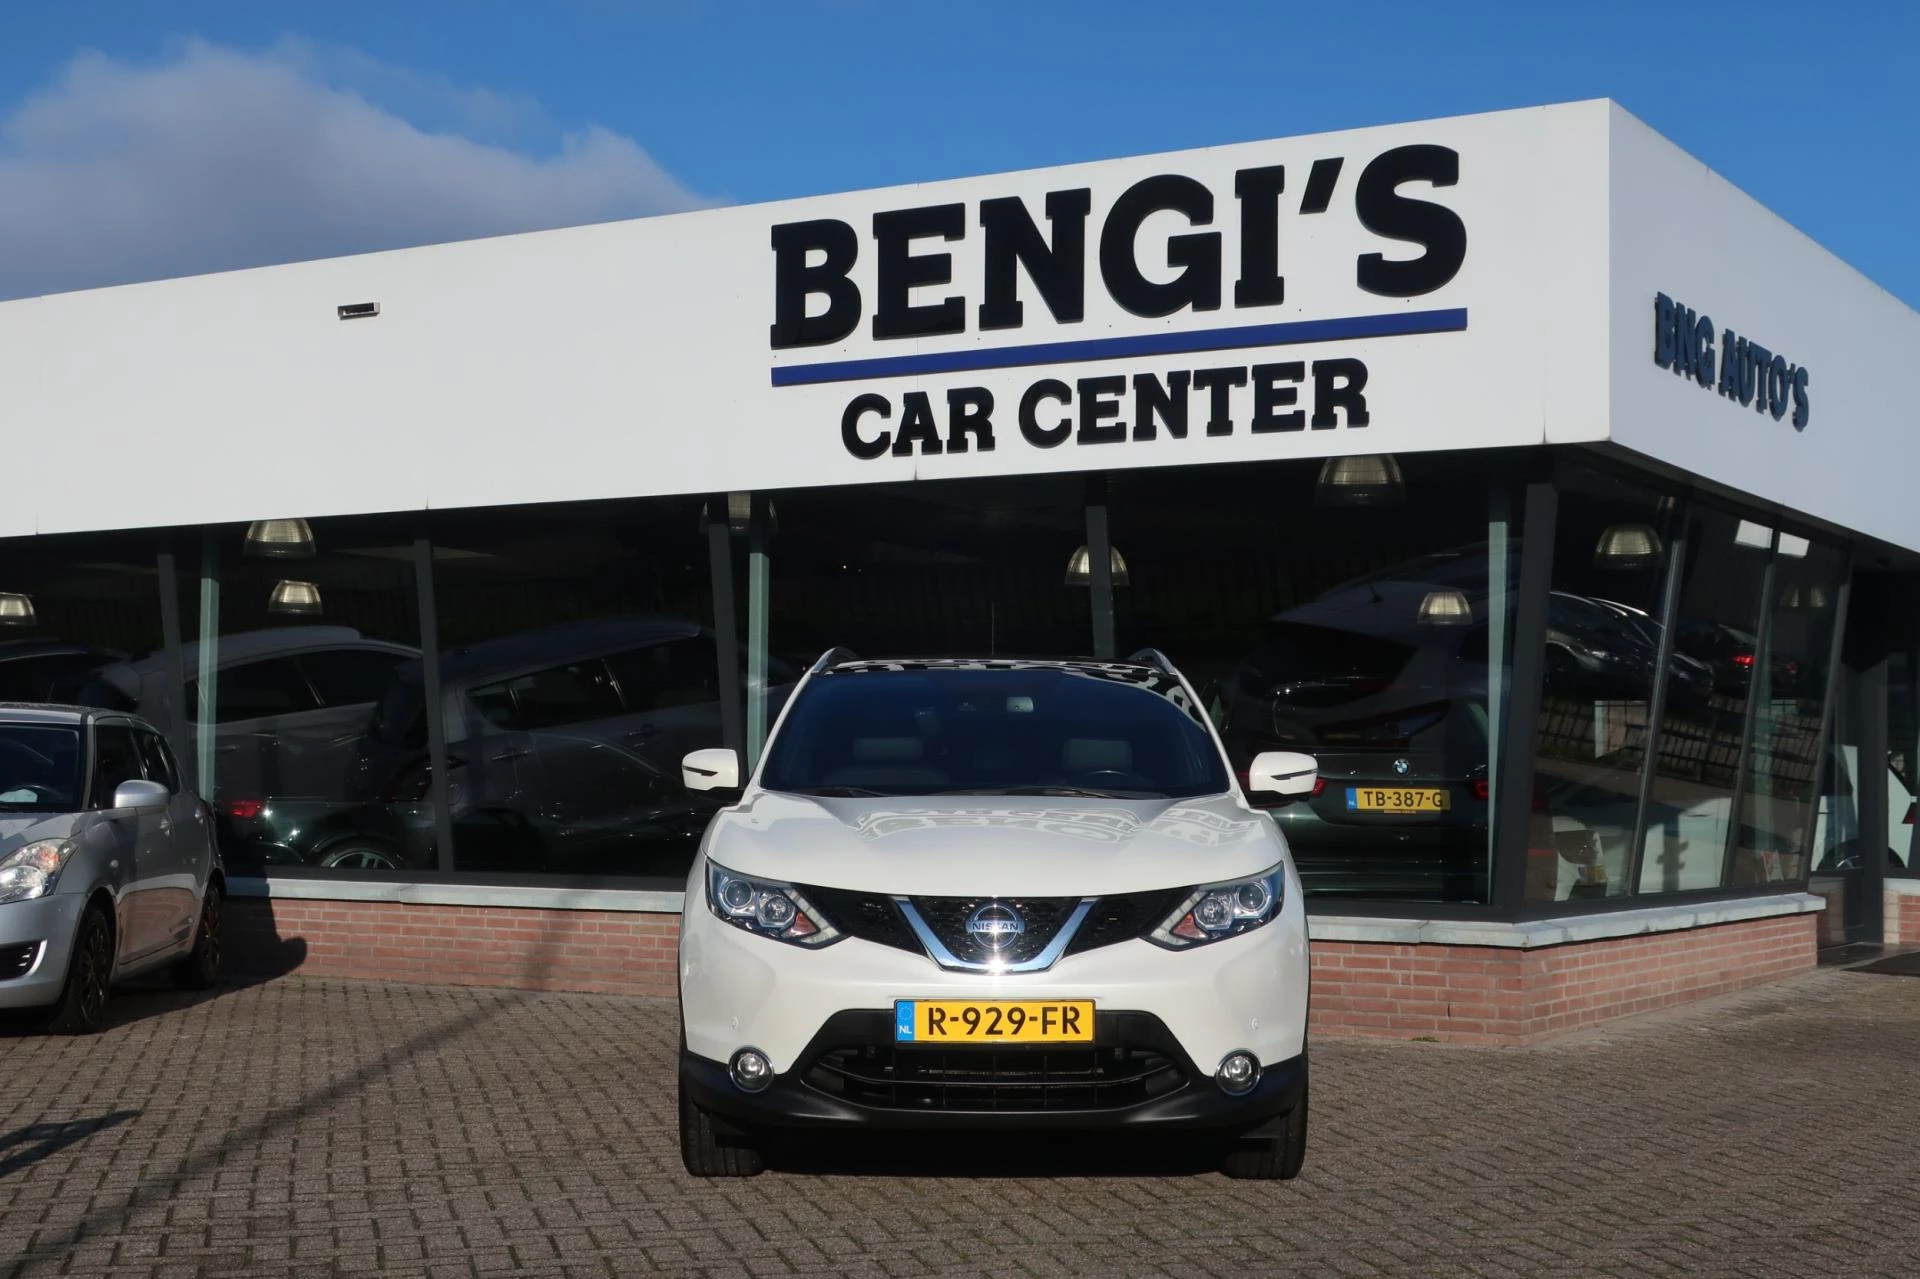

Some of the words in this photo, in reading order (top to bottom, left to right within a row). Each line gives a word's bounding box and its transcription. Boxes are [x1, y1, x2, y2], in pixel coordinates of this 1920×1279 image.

[770, 144, 1467, 350] BENGI'S
[1654, 291, 1716, 391] BNG
[1718, 328, 1809, 432] AUTO'S
[841, 386, 996, 460] CAR
[1018, 357, 1370, 449] CENTER
[1363, 791, 1443, 808] TB-387-G
[972, 922, 1019, 931] NISAN
[899, 1025, 913, 1035] NL
[928, 1006, 1081, 1036] R-929-FR
